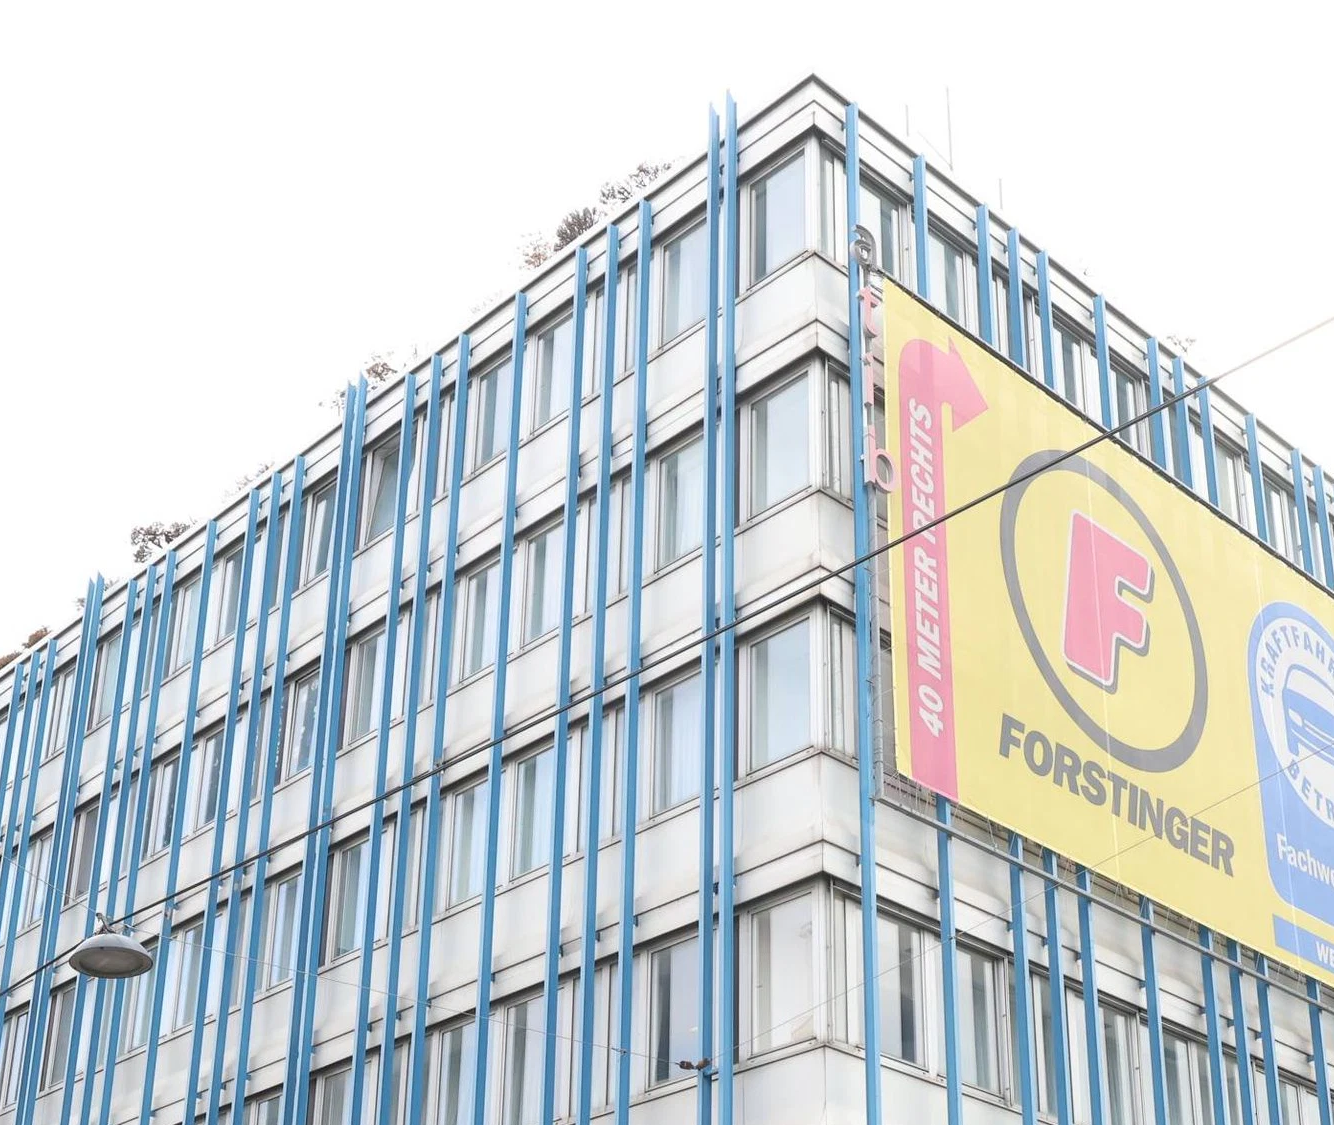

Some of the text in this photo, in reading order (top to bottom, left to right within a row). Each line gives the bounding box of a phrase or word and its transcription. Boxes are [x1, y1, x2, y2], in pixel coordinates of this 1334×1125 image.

[909, 398, 944, 738] 40 METER RECHTS
[1063, 509, 1155, 694] F
[999, 712, 1235, 878] FORSTINGER
